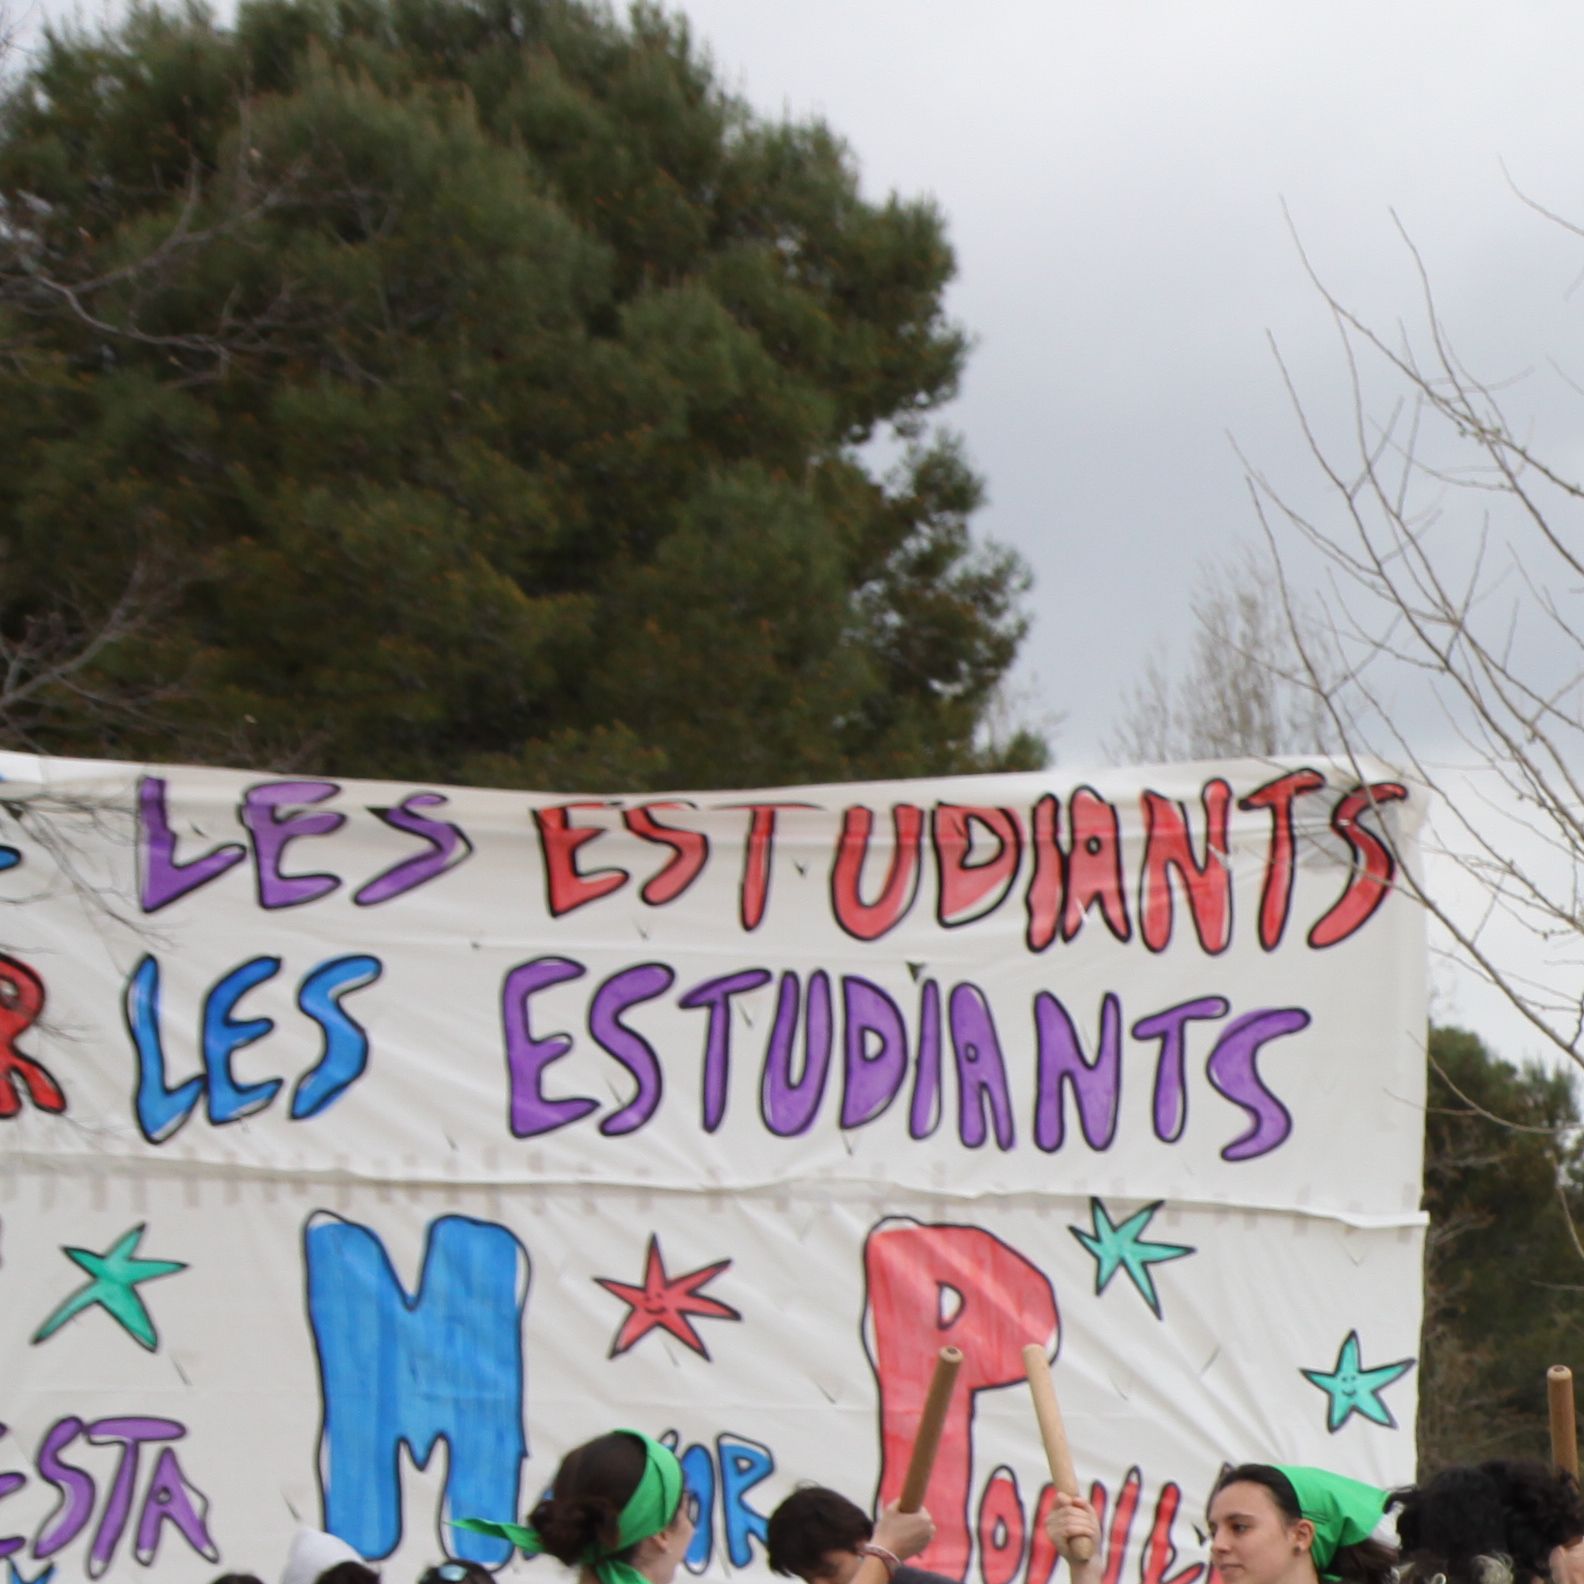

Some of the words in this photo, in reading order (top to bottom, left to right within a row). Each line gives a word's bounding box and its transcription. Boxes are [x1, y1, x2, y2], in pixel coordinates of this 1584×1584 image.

[137, 775, 474, 913] LES
[531, 768, 1409, 956] ESTUDIANTS
[122, 952, 383, 1144] LES
[500, 955, 1312, 1162] ESTUDIANTS
